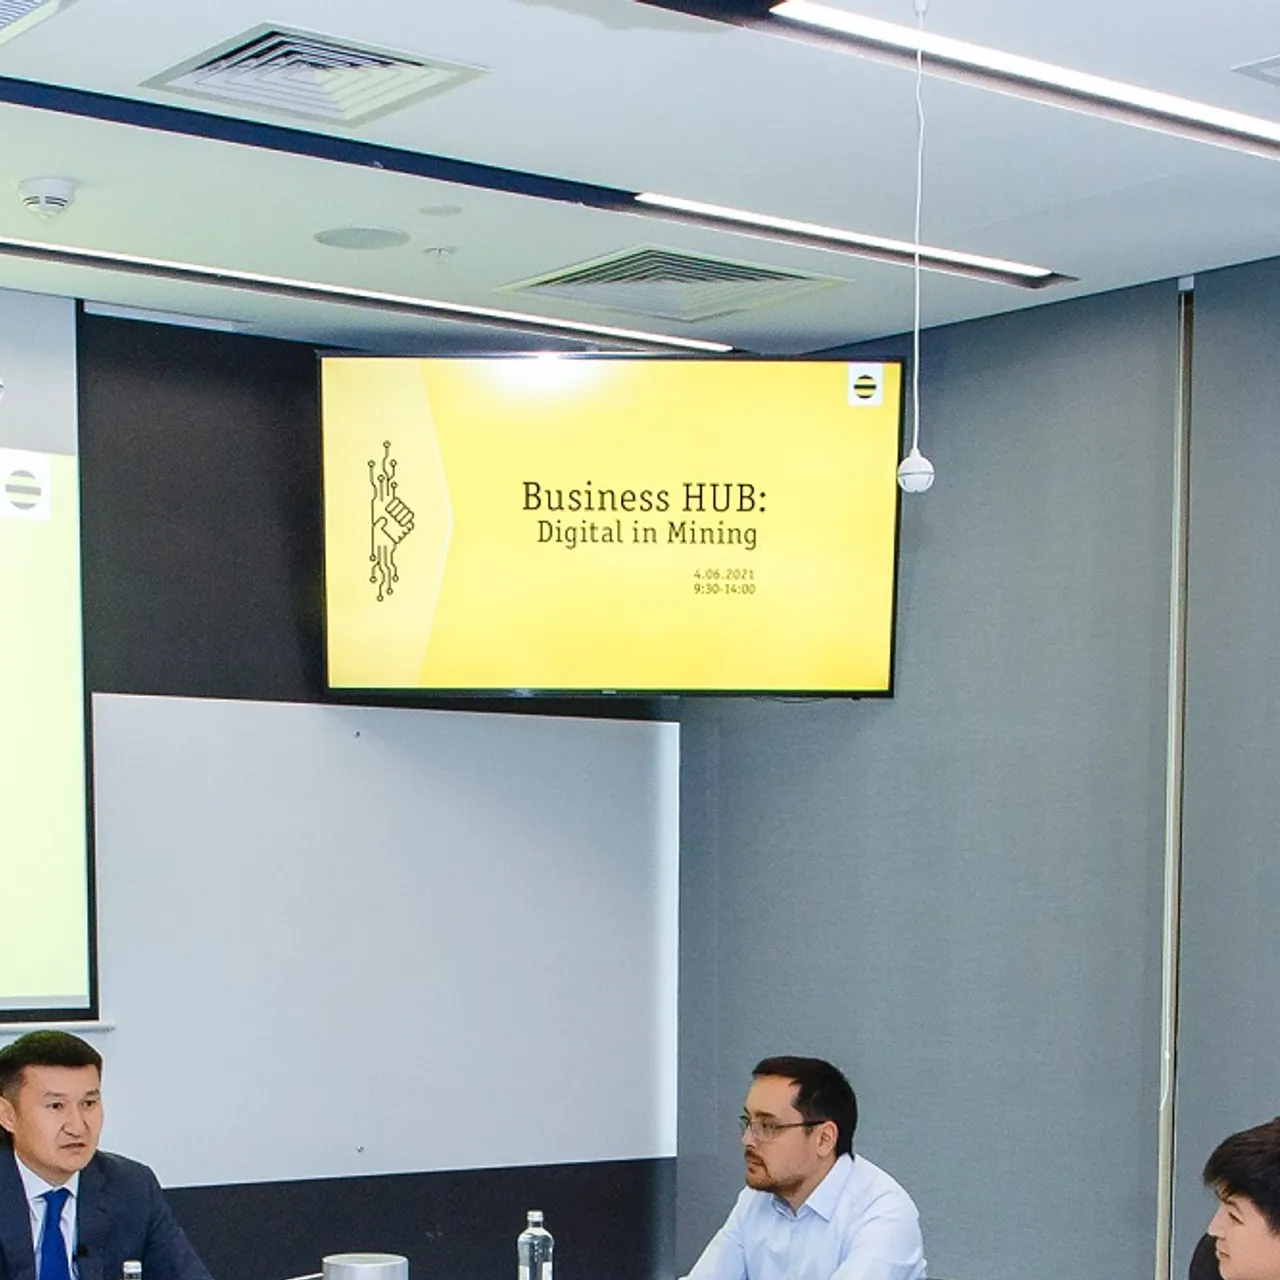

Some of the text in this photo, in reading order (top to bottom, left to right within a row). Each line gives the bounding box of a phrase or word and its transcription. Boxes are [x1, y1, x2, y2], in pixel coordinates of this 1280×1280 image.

[521, 479, 767, 514] Business HUB:
[536, 518, 758, 552] Digital in Mining
[693, 568, 756, 581] 4.06.2021
[693, 583, 757, 596] 9:30-14:00
